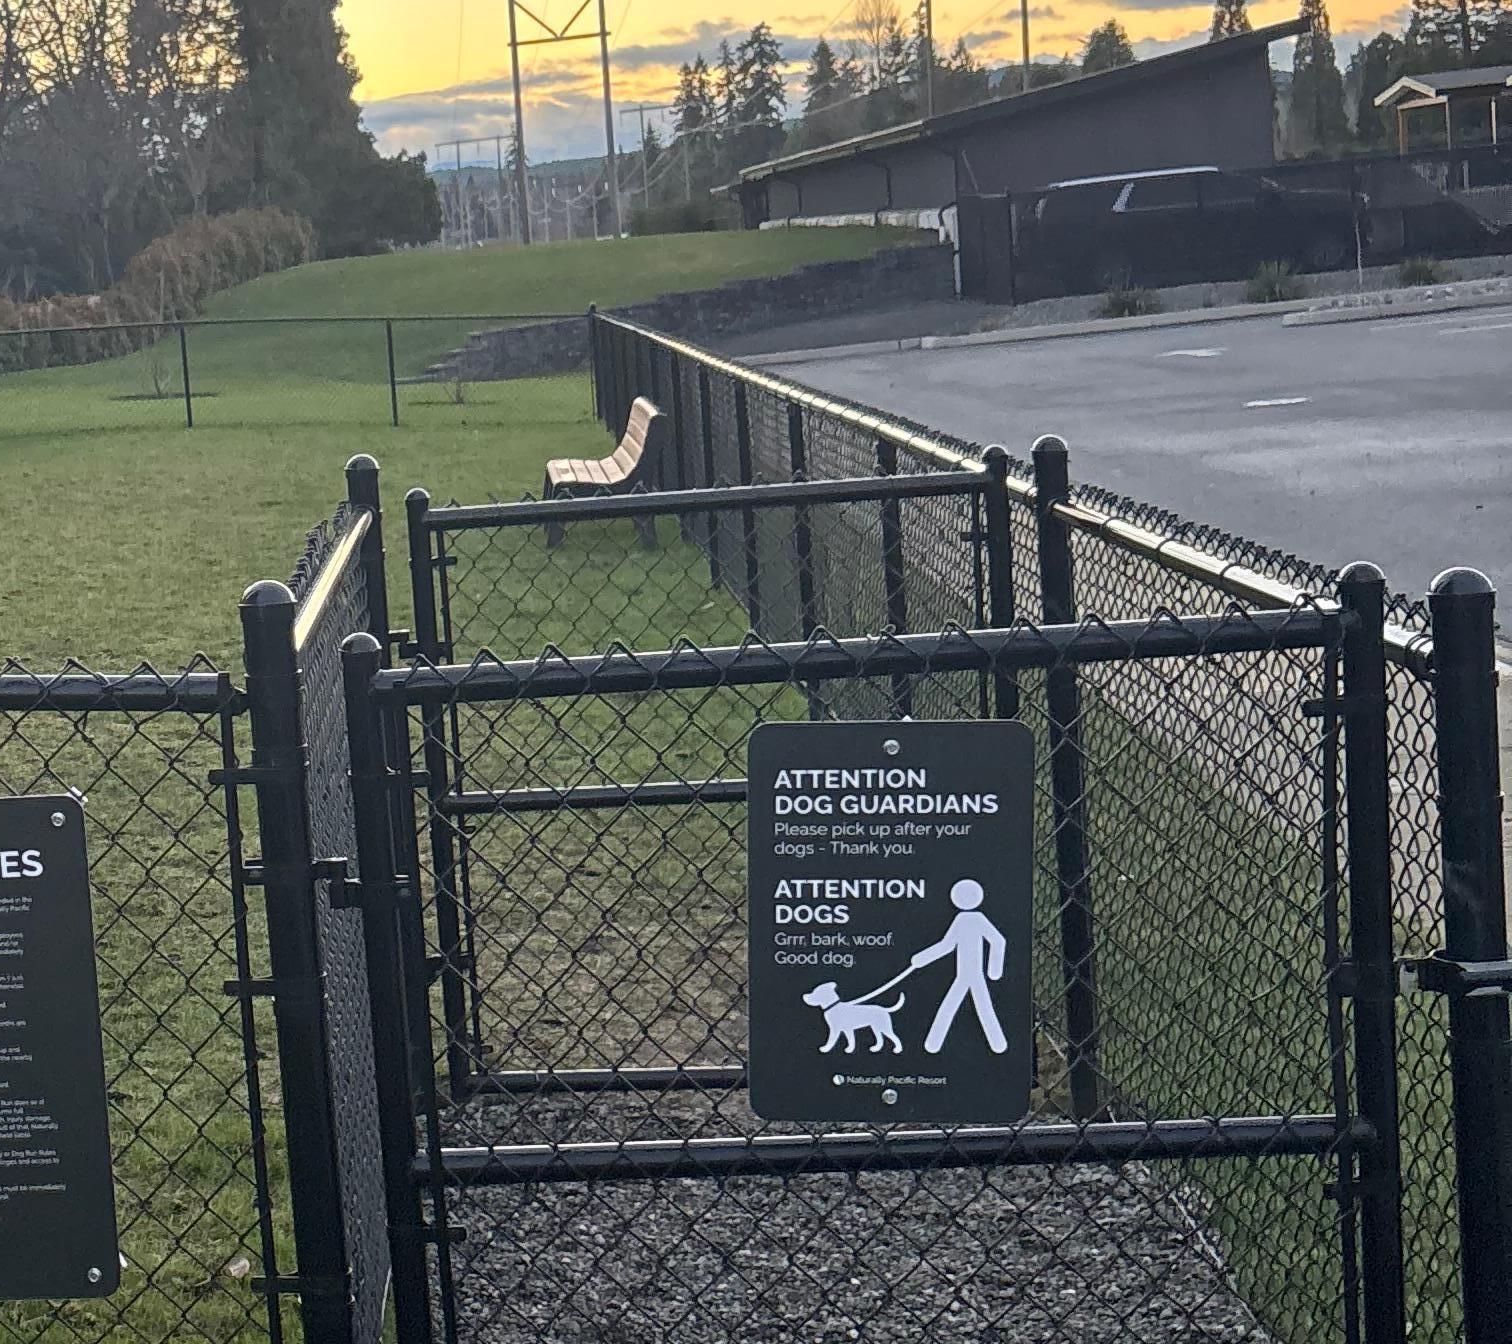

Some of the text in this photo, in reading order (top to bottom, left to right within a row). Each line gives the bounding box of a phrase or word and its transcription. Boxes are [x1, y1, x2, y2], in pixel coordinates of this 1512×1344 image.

[774, 769, 925, 788] ATTENTION
[775, 794, 999, 815] DOG GUARDIANS
[774, 821, 972, 839] Please pick up after your
[774, 841, 815, 858] dogs
[830, 840, 879, 856] Thank
[774, 879, 925, 899] ATTENTION
[775, 904, 850, 924] DOGS
[774, 950, 818, 965] Good
[846, 1075, 947, 1086] Naturally Pacific Resort
